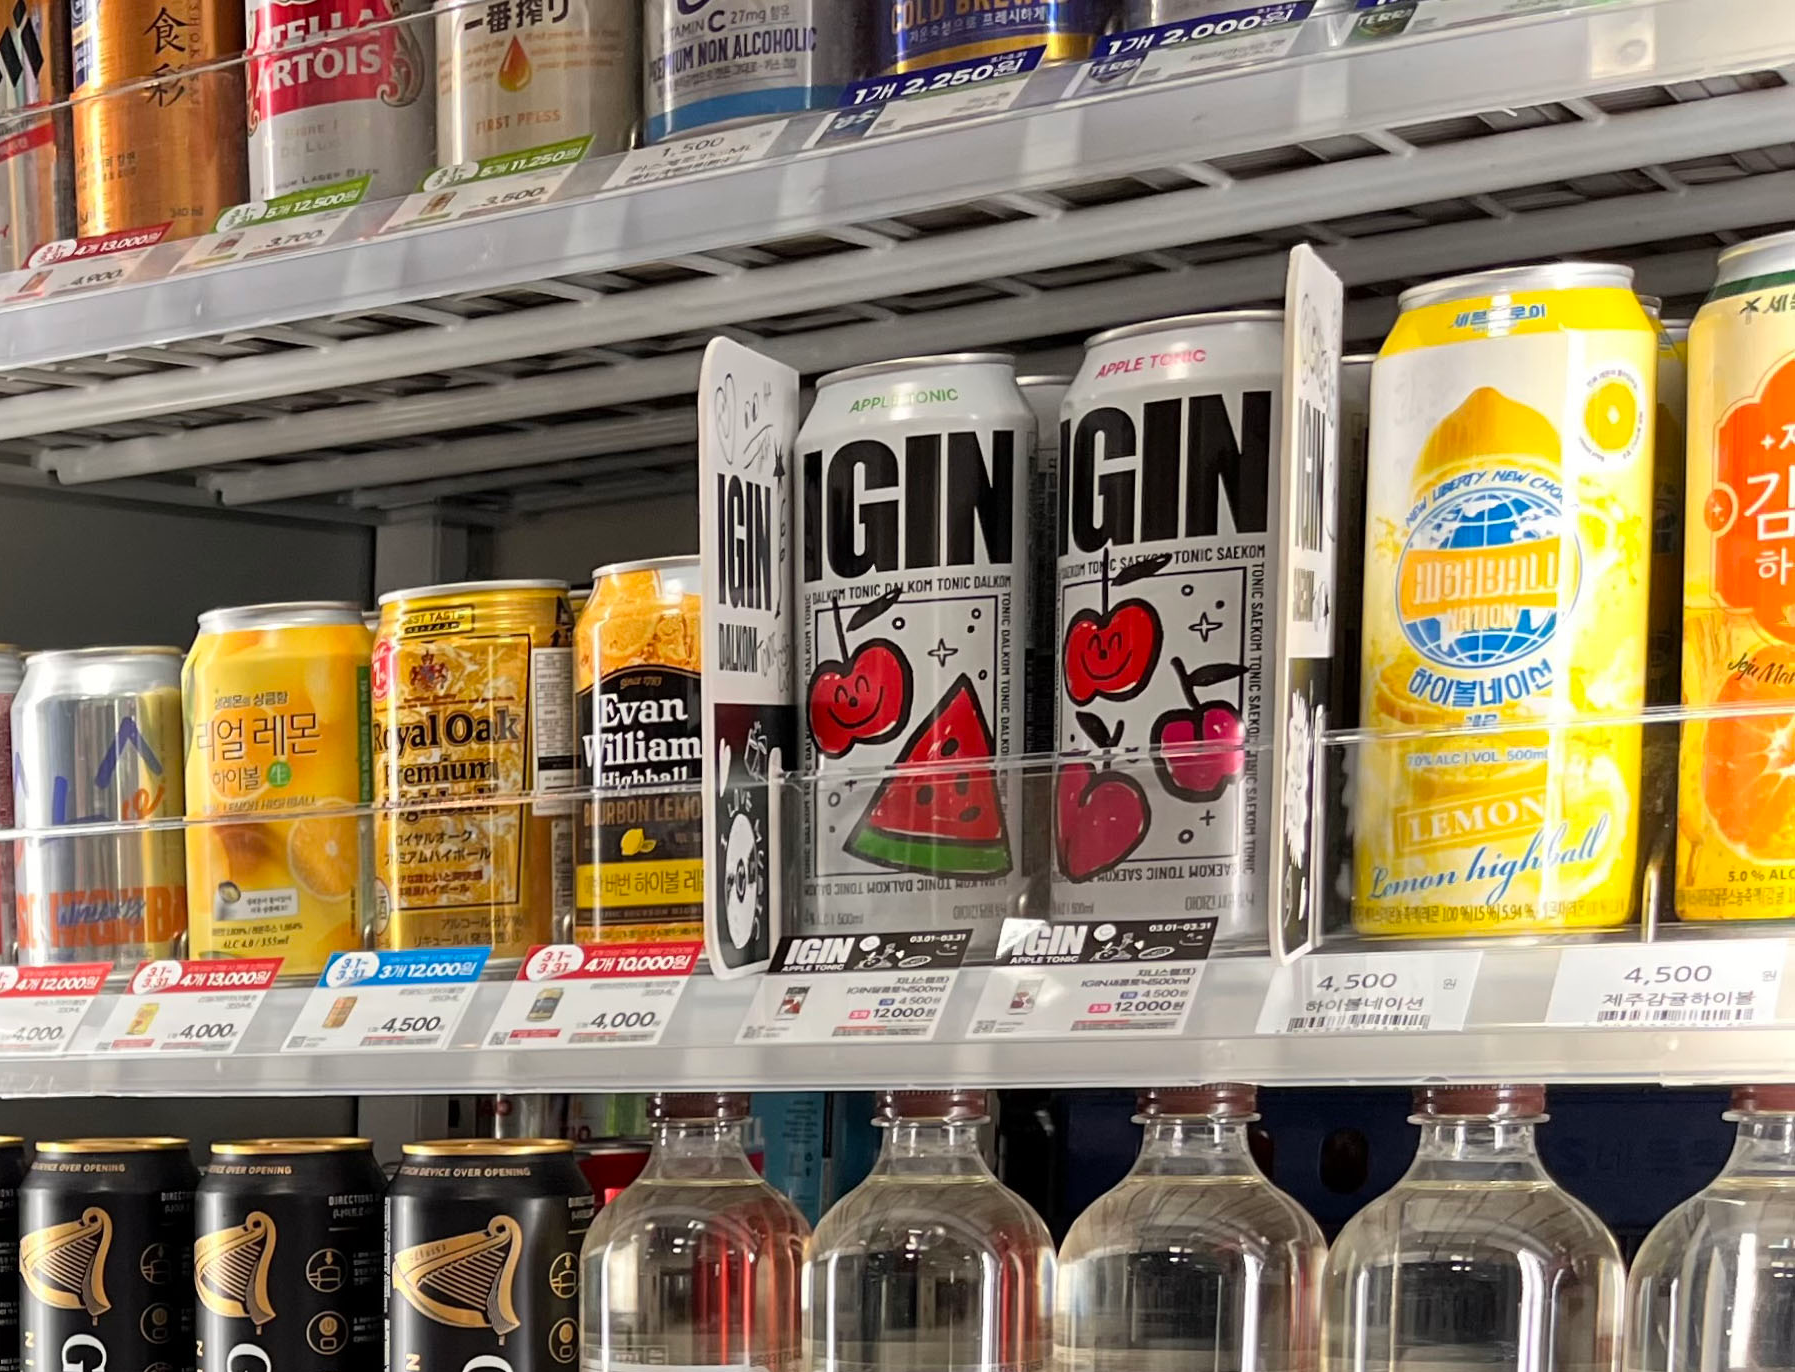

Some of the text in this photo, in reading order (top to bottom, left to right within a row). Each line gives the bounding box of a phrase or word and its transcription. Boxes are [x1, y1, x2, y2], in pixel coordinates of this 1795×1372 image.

[1108, 9, 1292, 56] 1개 2,000원
[144, 7, 188, 108] 食彩
[697, 28, 817, 66] NON ALCOHOLIC
[855, 82, 898, 106] 1개
[899, 56, 1023, 97] 2,250원
[510, 147, 582, 171] 11,250원
[904, 388, 959, 407] TONIC
[1058, 388, 1272, 559] IGIN
[803, 429, 1015, 585] IGIN
[716, 473, 773, 613] IGIN
[937, 576, 972, 592] TONIC
[718, 622, 759, 673] DALKOM
[599, 694, 688, 727] Evan
[253, 711, 321, 757] 레몬
[445, 707, 520, 745] Oak
[212, 766, 260, 792] 하이볼
[585, 952, 690, 972] 4개 10,000원
[784, 937, 855, 965] IGIN
[1009, 955, 1080, 966] APPLE TONIC
[40, 974, 99, 991] 12,000원
[206, 969, 271, 986] 13,000원
[379, 960, 476, 979] 3개 12,000원
[1305, 995, 1424, 1013] 하이볼네이션
[1602, 989, 1756, 1009] 제주감귤하이볼
[453, 1167, 531, 1178] OVER OPENING
